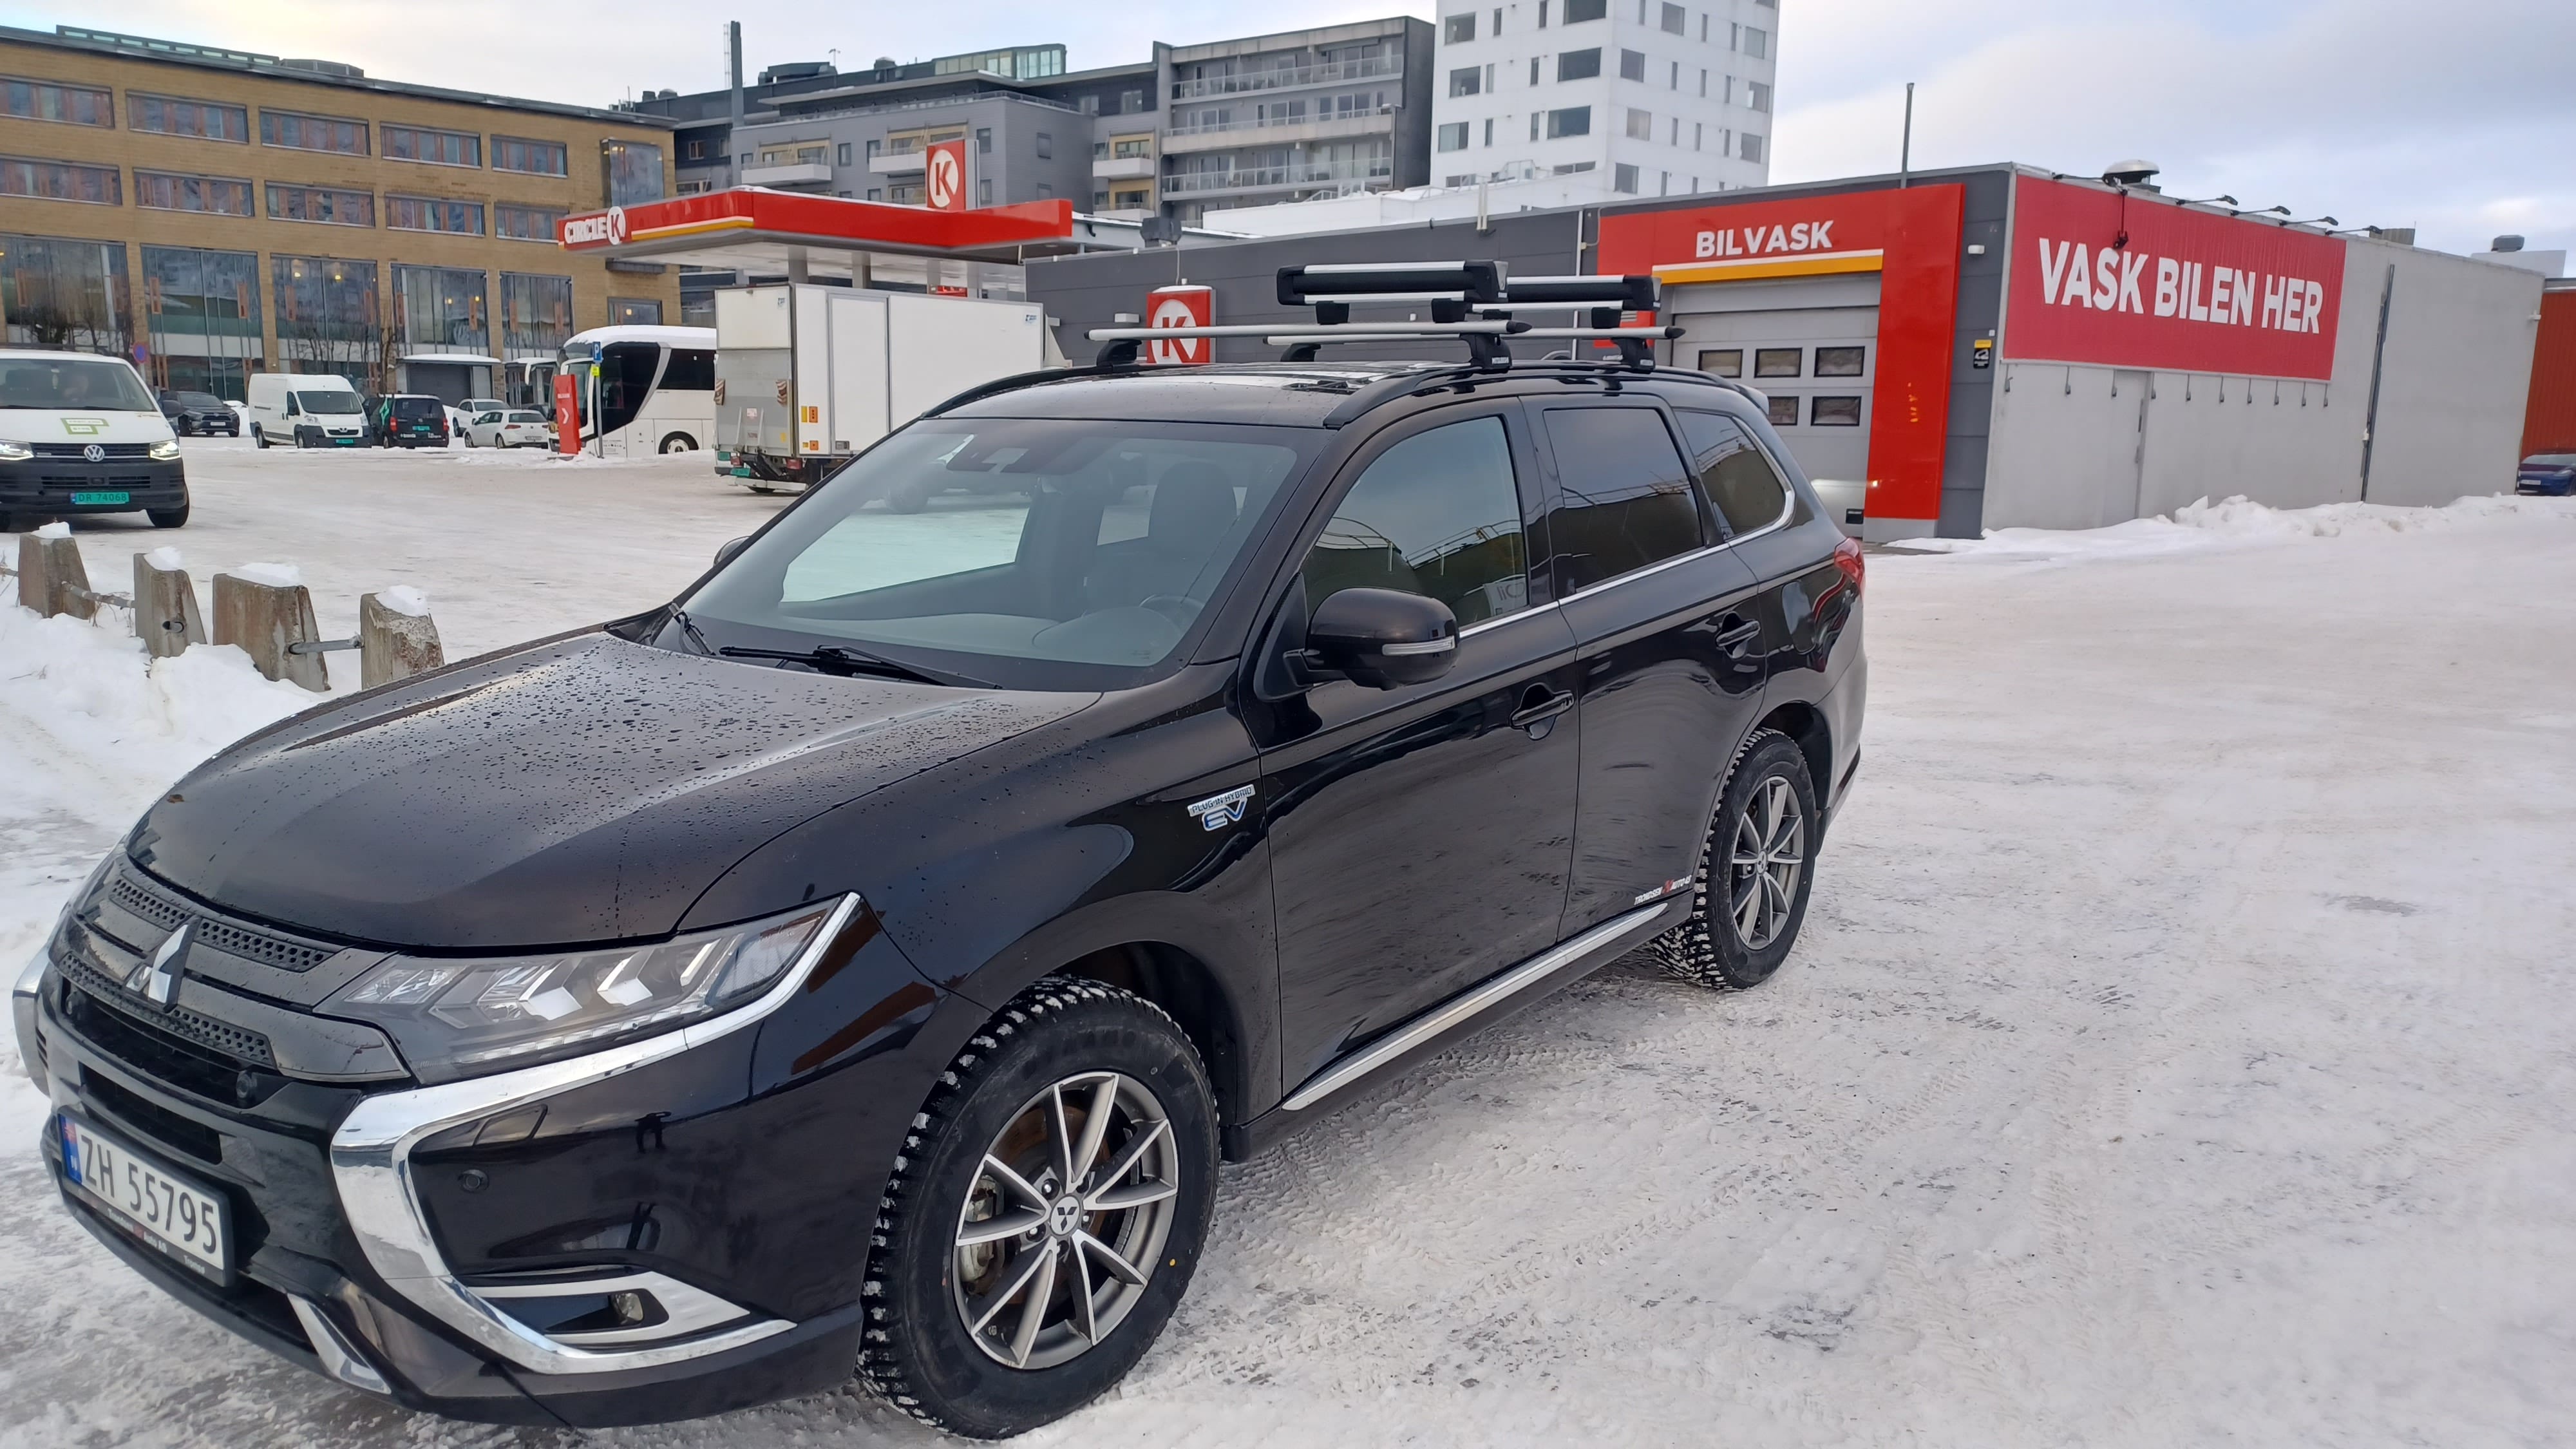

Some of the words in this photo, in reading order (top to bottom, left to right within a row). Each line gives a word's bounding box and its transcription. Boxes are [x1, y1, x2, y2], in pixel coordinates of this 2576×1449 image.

[564, 216, 607, 243] CIRCLE
[1696, 220, 1833, 258] BILVASK
[2039, 238, 2148, 314] VASK
[2154, 257, 2256, 327] BILEN
[2262, 274, 2323, 334] HER
[594, 343, 600, 359] P
[1225, 787, 1252, 802] HYBRID
[1204, 800, 1245, 829] EV
[81, 1135, 115, 1198] ZH
[128, 1162, 216, 1255] 55795
